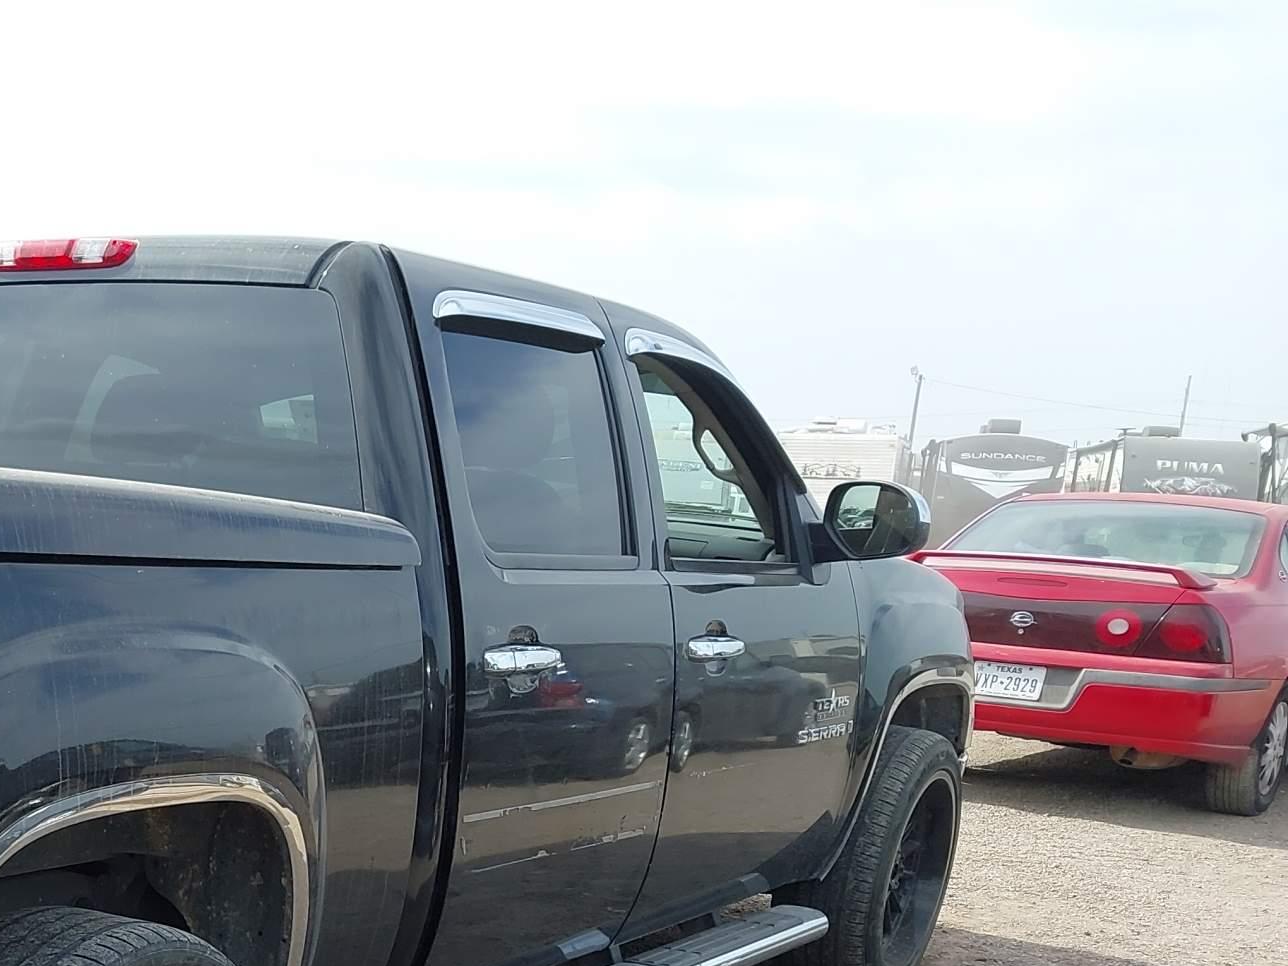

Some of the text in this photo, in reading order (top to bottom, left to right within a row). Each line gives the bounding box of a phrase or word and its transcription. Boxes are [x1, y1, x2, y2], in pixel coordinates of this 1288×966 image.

[960, 452, 1047, 463] SUNDANCE
[996, 665, 1024, 674] TEXAS
[814, 688, 850, 713] TEXAS
[798, 723, 846, 744] SIERRA
